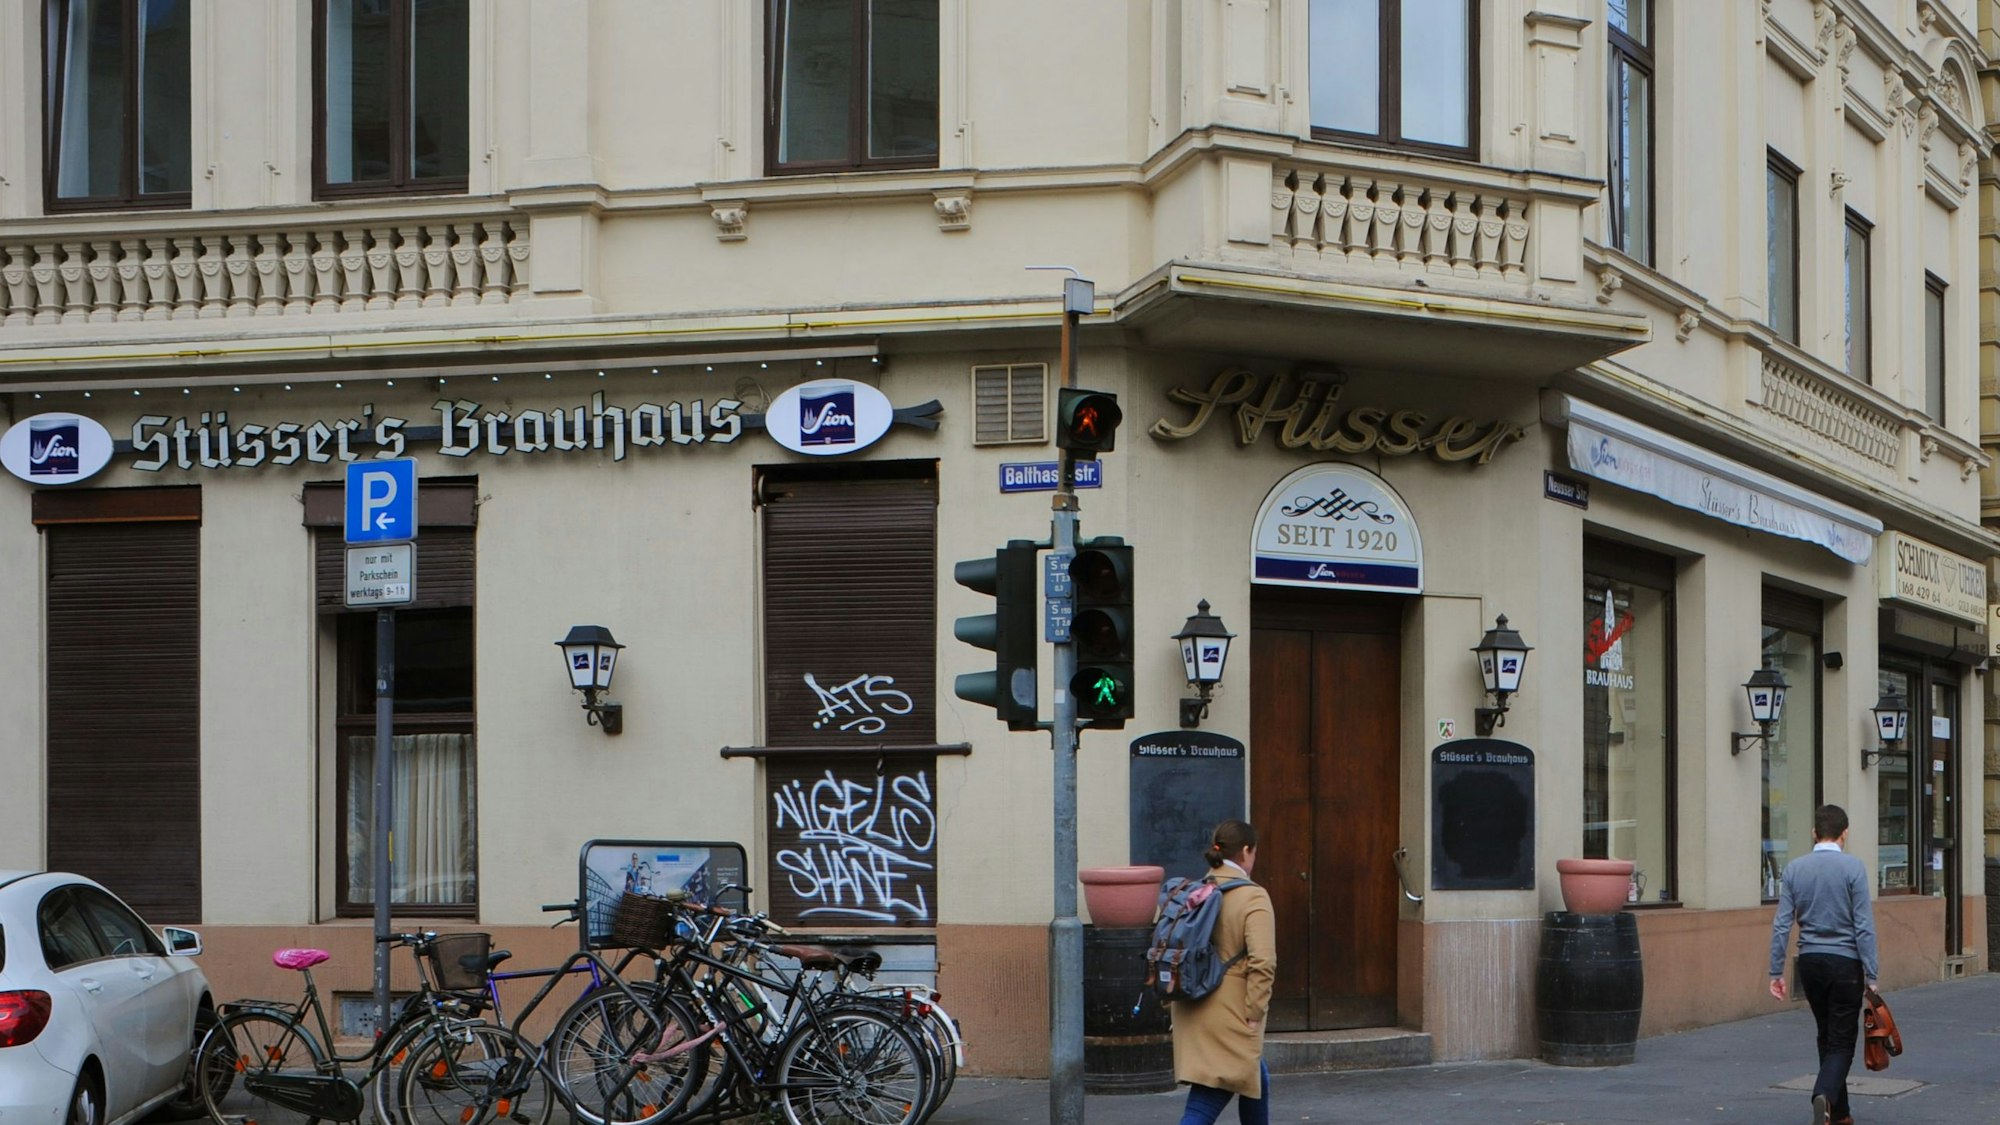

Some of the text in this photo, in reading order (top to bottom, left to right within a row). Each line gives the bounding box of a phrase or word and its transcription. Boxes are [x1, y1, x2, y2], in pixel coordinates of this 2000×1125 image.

[131, 390, 744, 472] Stüsser's Brauhaus
[801, 402, 855, 434] Sion
[1148, 369, 1526, 466] Stüsser
[30, 434, 79, 464] Sion
[1005, 464, 1097, 485] Balthasstr.
[362, 471, 397, 531] P
[1277, 523, 1397, 552] SEIT 1920
[359, 569, 398, 581] Parkschein
[1897, 540, 1940, 585] SCHMUCK
[1958, 562, 1985, 600] UHREN
[350, 586, 384, 600] werktags
[1585, 669, 1634, 690] BRAUHAUS
[1190, 745, 1238, 758] Brauhaus
[1485, 752, 1528, 765] Brauhaus
